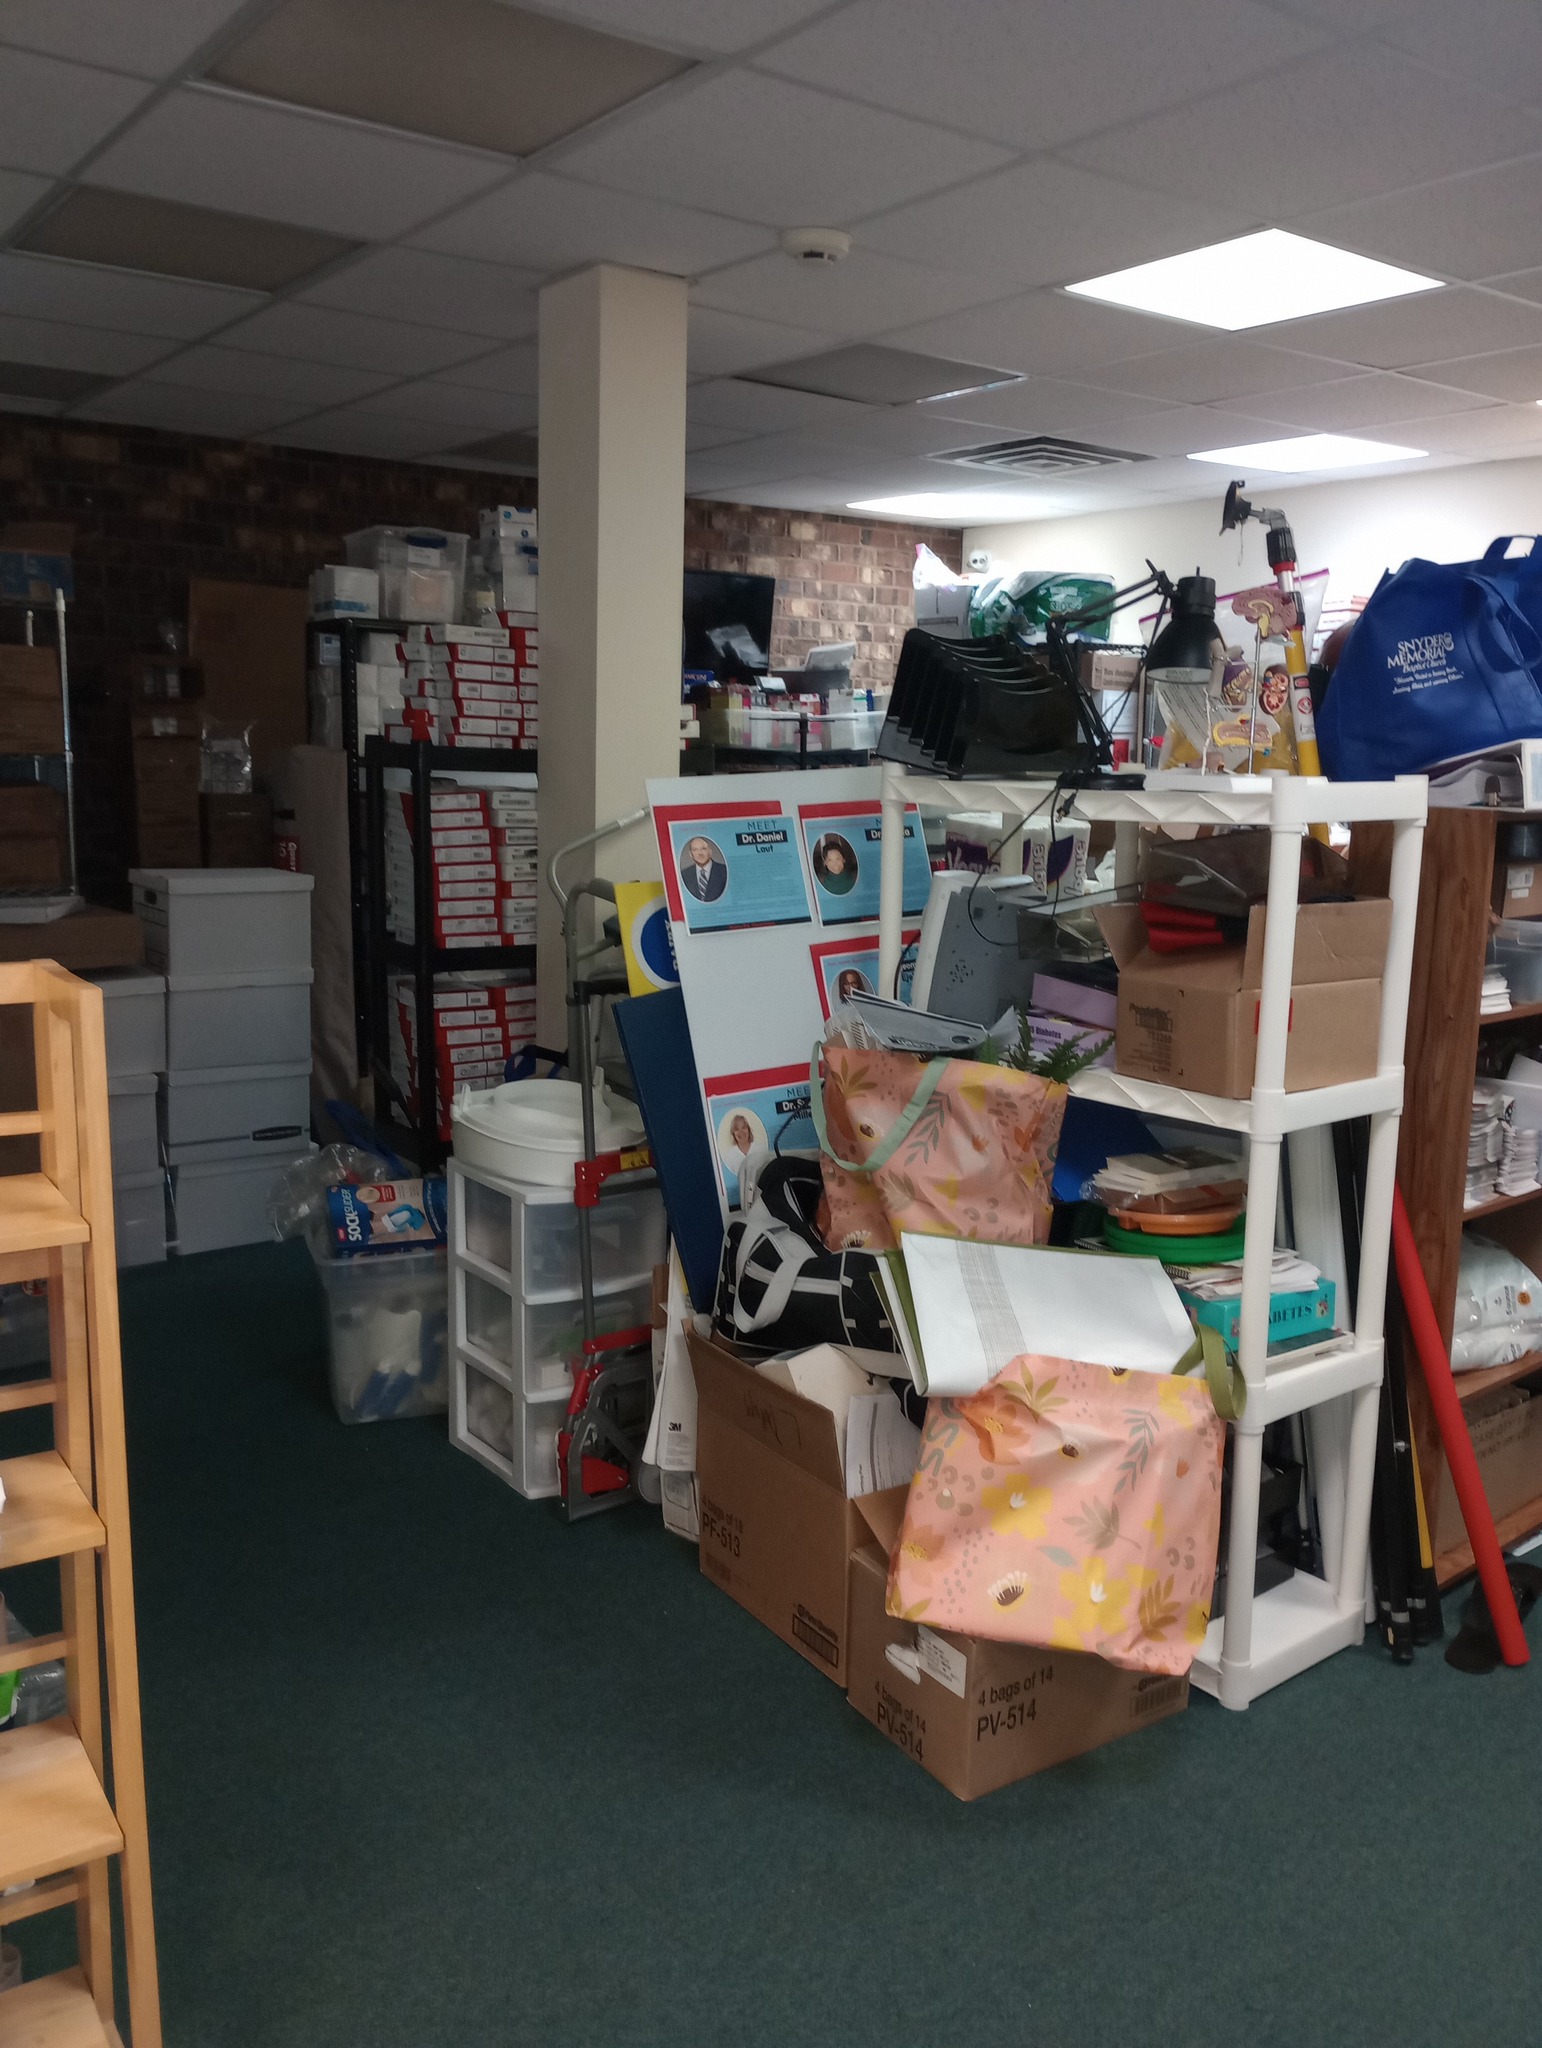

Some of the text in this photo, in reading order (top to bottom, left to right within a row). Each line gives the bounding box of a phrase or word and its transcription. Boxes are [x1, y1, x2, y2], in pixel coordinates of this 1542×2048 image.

[1398, 633, 1446, 652] SNYDER
[1387, 646, 1446, 669] MEMORIAL
[747, 820, 777, 831] MEET
[741, 831, 784, 844] Dr. Daniel
[786, 1085, 811, 1099] MEE
[782, 1101, 797, 1112] Dr.
[1268, 1304, 1313, 1325] ABETES
[668, 1421, 682, 1433] 3M
[702, 1511, 741, 1558] PF-513
[979, 1666, 1053, 1706] 4 bags of 14
[874, 1681, 880, 1694] 4
[904, 1707, 914, 1723] of
[915, 1714, 926, 1735] 14
[976, 1698, 1037, 1742] PV-514
[877, 1701, 924, 1762] PV-514
